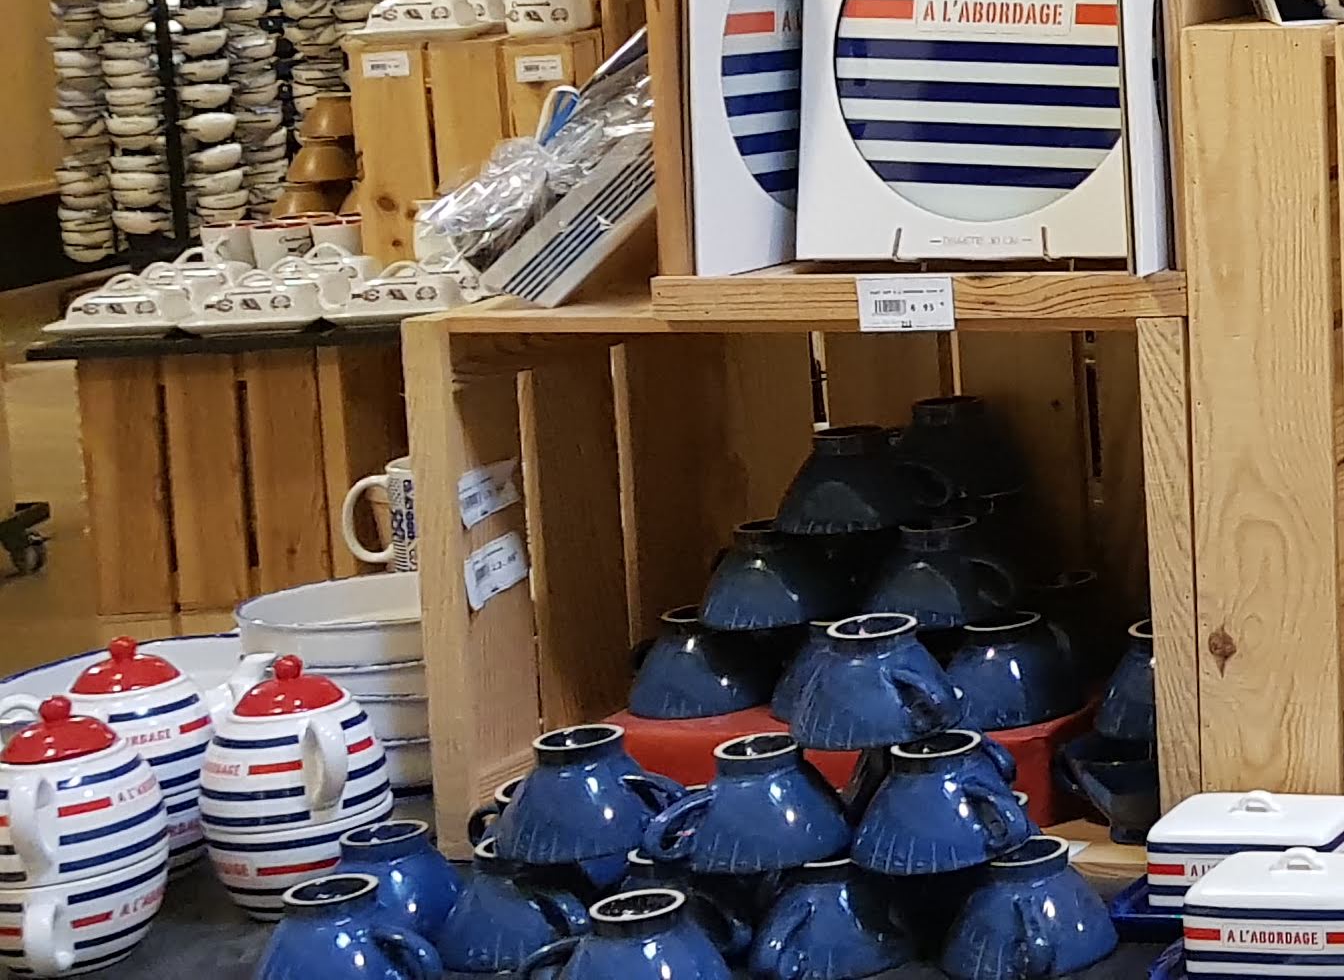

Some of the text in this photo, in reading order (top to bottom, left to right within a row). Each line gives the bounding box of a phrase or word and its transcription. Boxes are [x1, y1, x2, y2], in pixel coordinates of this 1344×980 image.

[923, 0, 1063, 26] A L'ABORDAGE
[1191, 864, 1198, 877] A
[1227, 929, 1319, 945] A L'ABORDAGE
